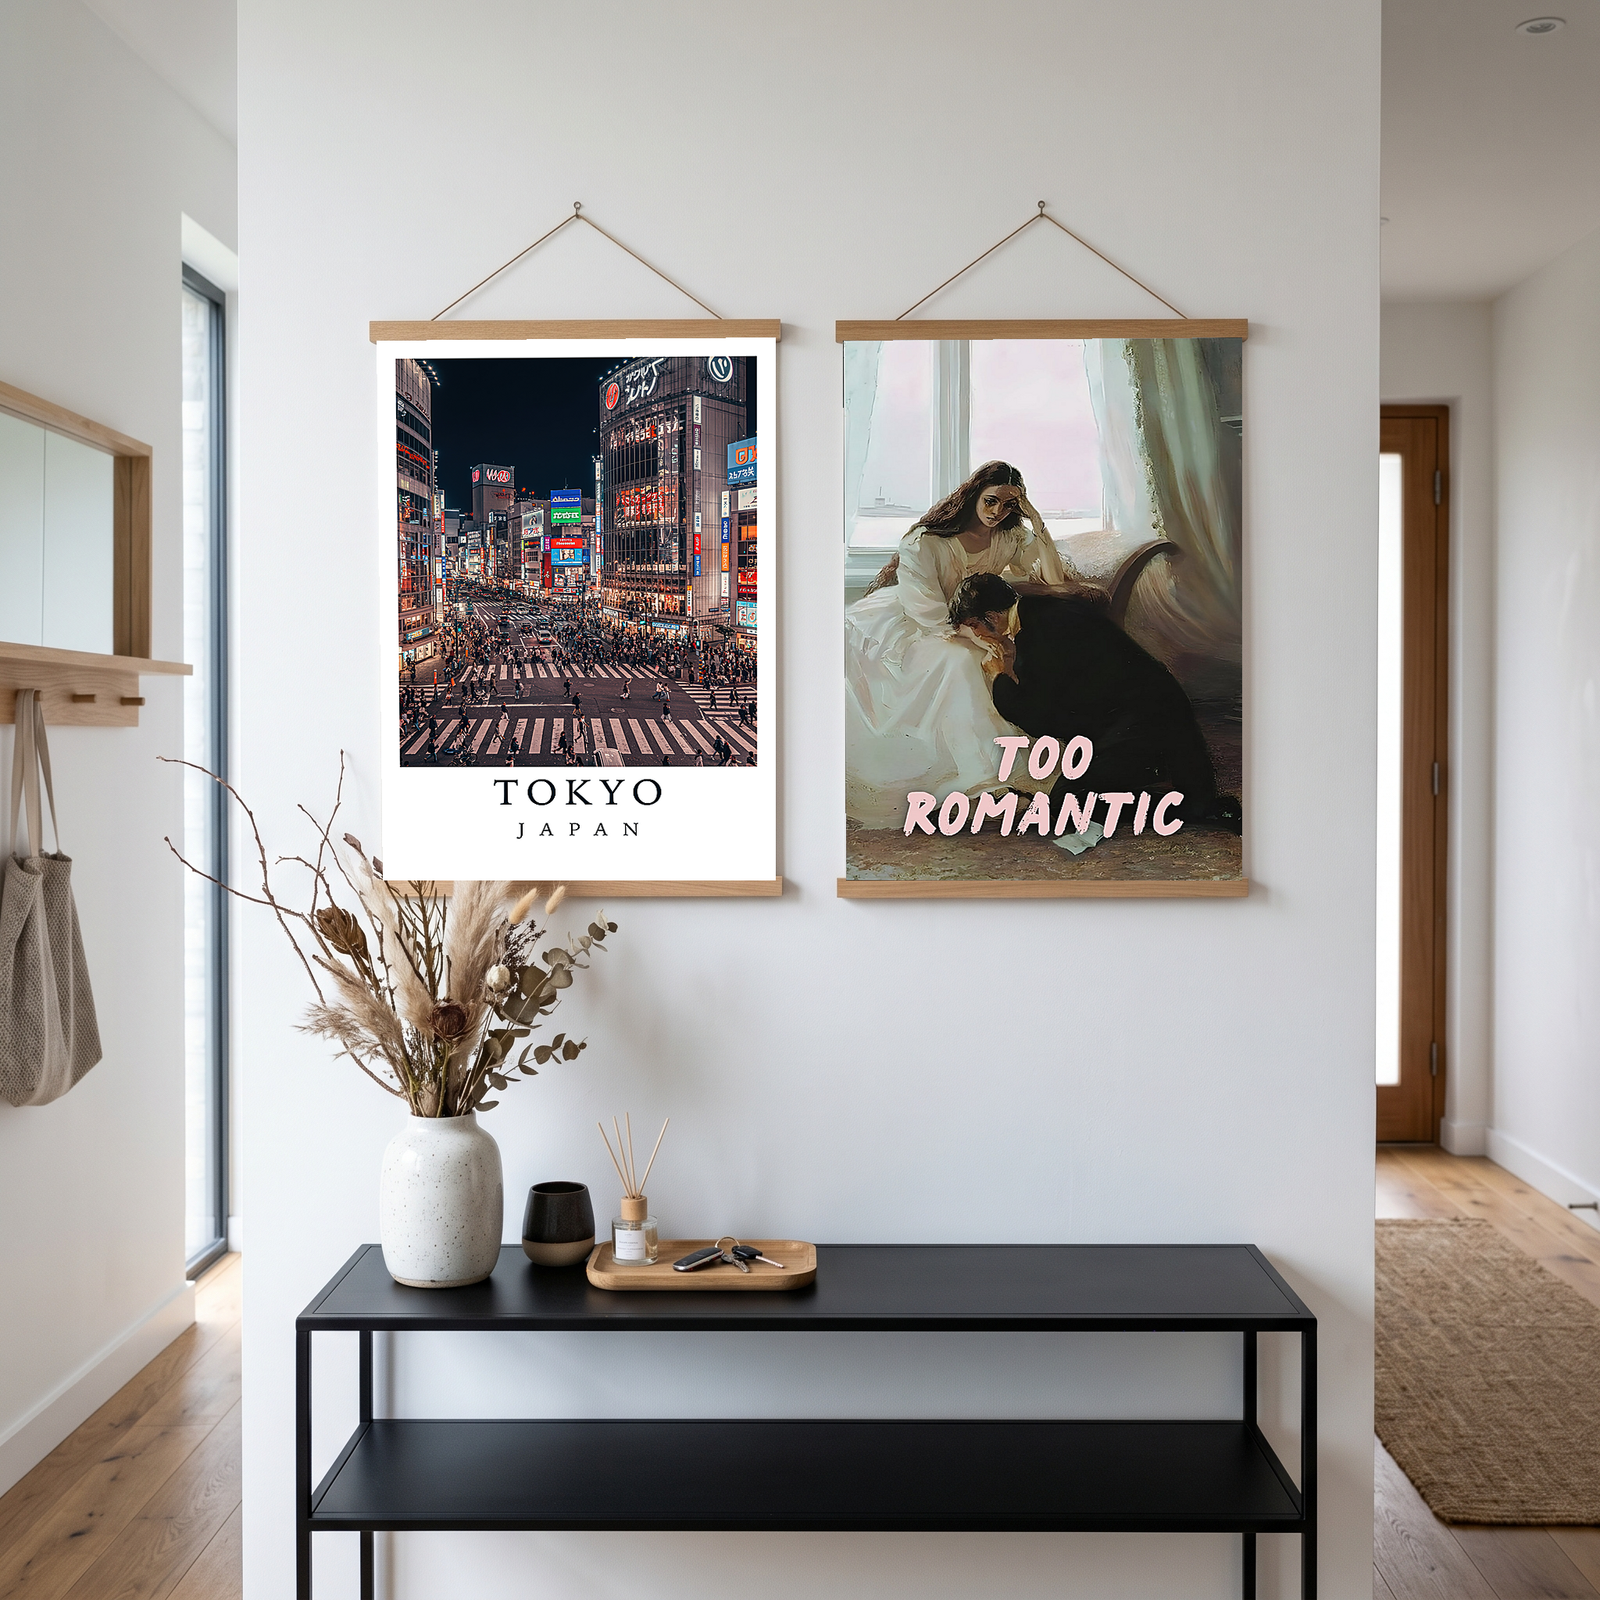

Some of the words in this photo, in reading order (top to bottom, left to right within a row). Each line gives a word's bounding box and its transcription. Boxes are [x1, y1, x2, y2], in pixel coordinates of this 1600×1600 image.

[993, 734, 1094, 782] TOO
[493, 778, 662, 805] TOKYO
[516, 822, 639, 840] JAPAN
[903, 790, 1185, 838] ROMANTIC
